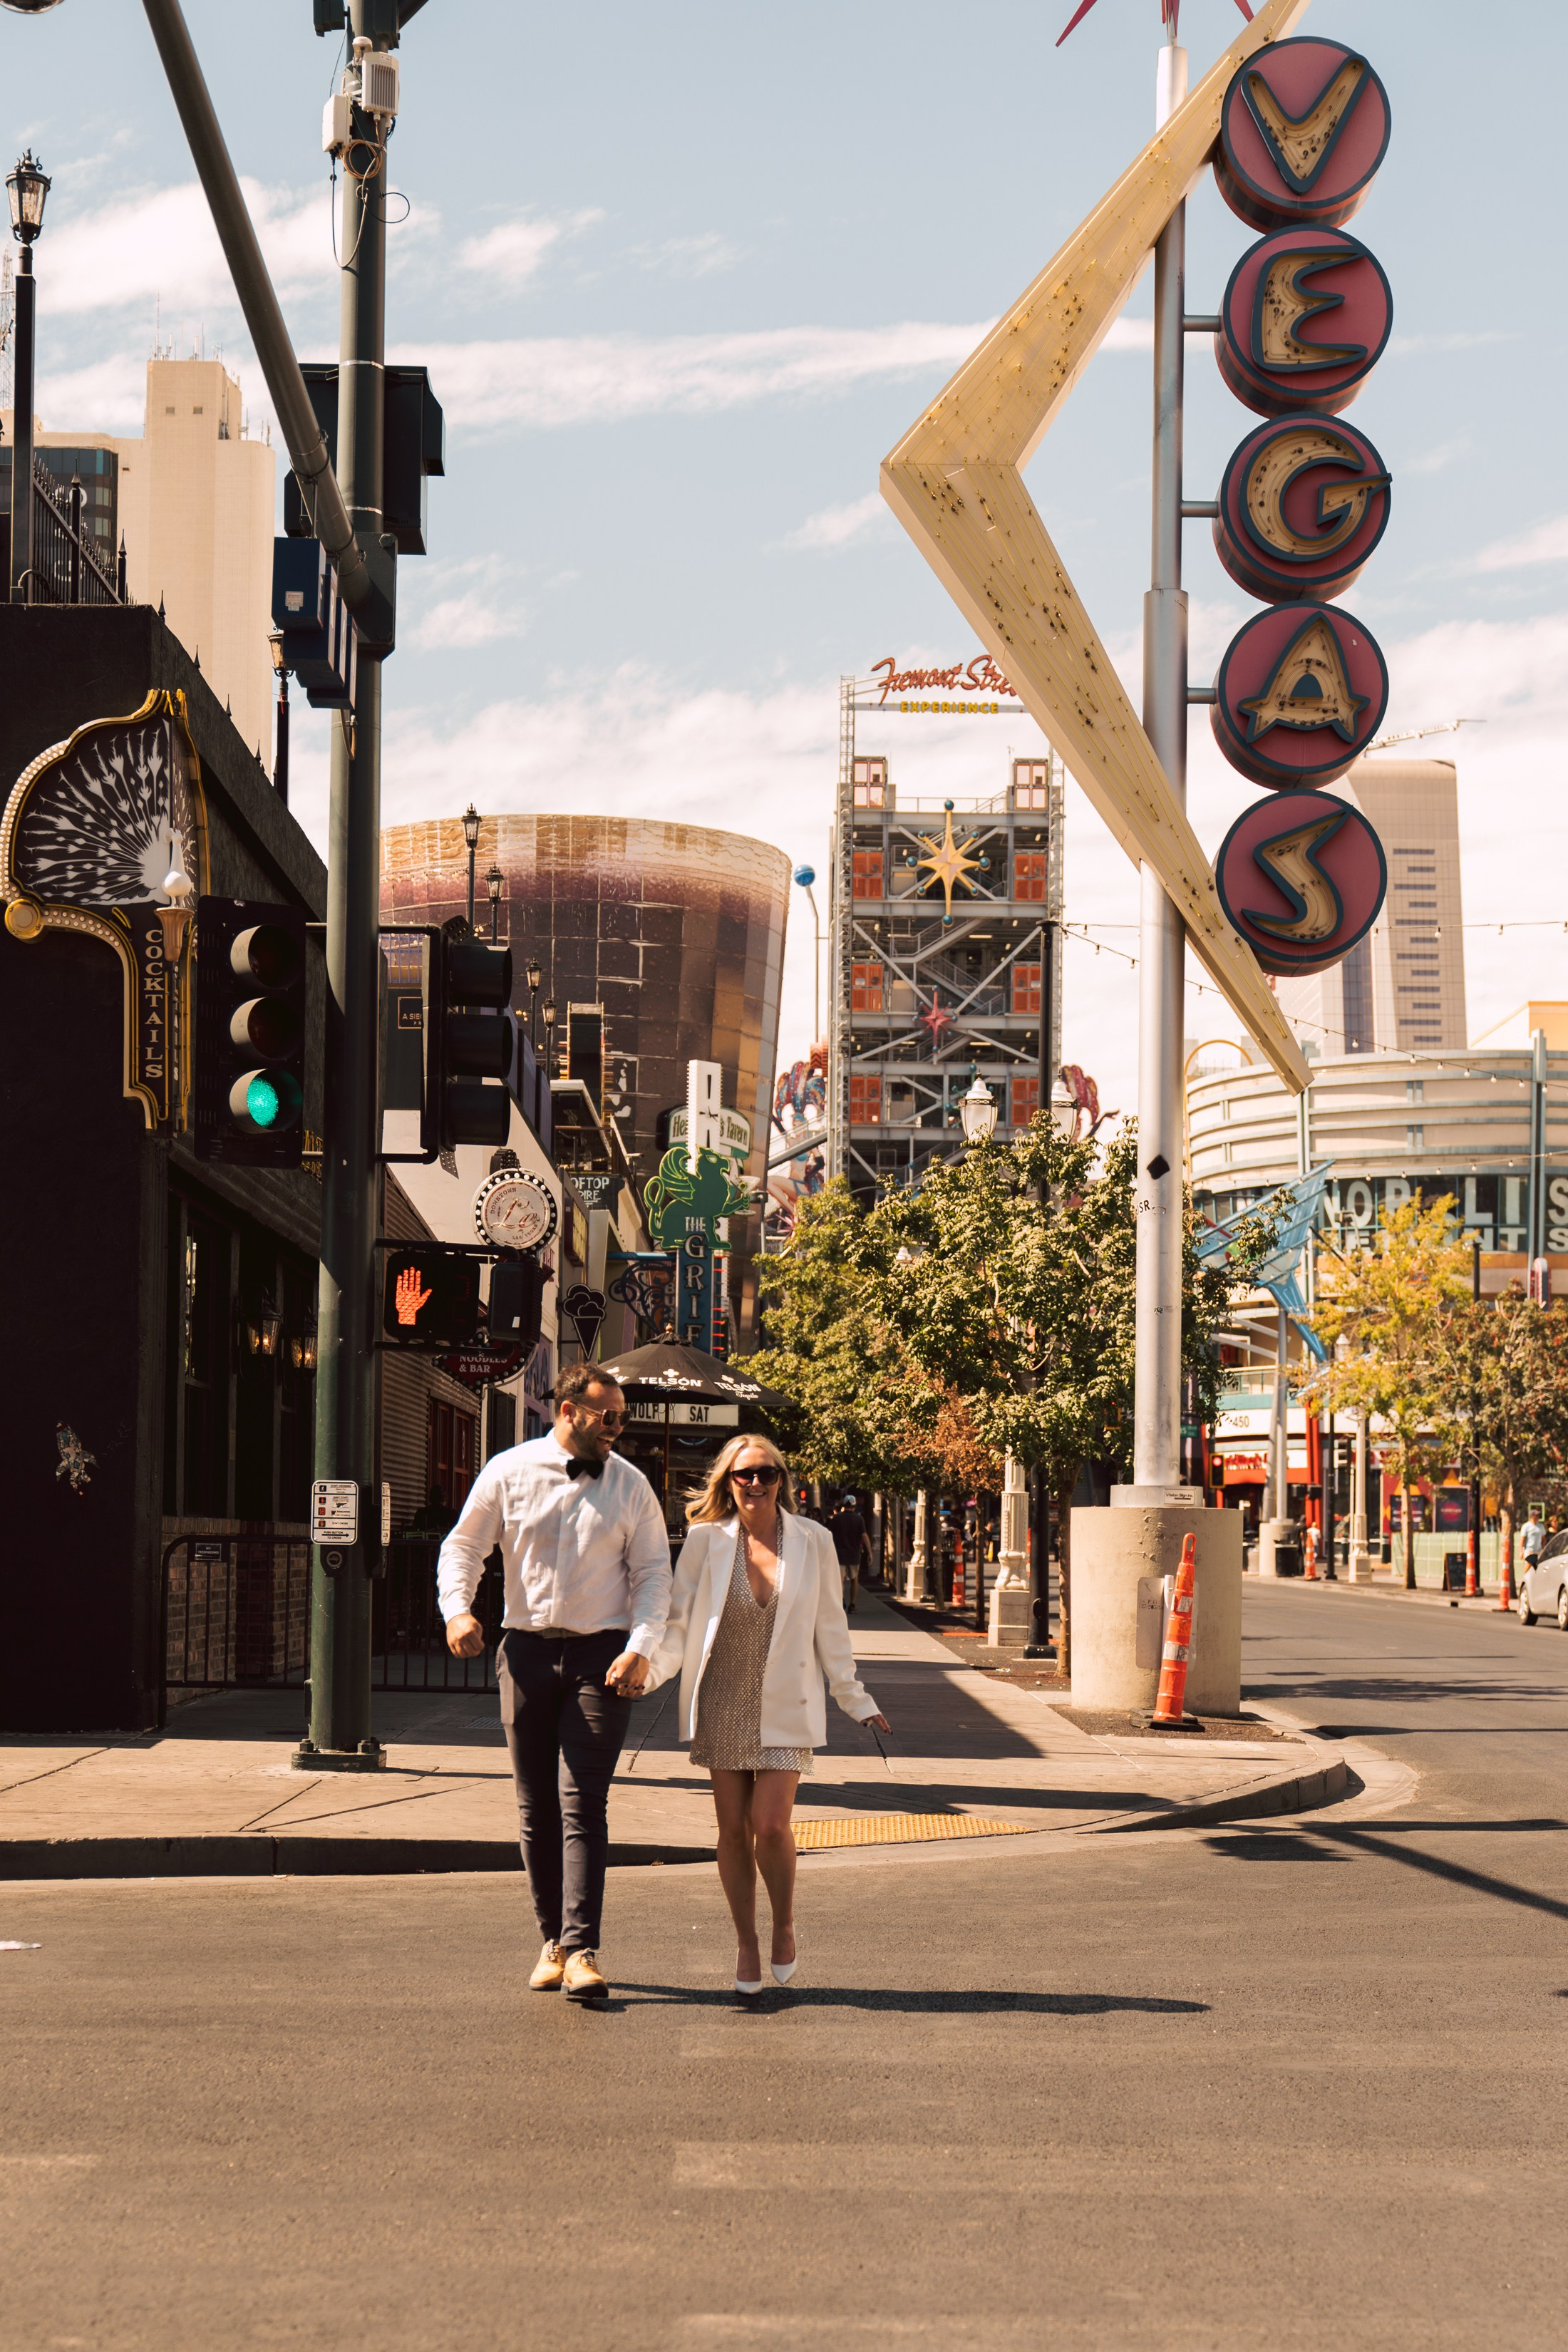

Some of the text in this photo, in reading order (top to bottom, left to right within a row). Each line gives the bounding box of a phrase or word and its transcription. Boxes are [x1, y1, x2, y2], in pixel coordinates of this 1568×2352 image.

[1238, 53, 1392, 944] VEGAS
[871, 657, 962, 706] Fremont
[900, 701, 999, 713] EXPERIENCE
[143, 929, 164, 1078] COCKTAILS
[726, 1115, 748, 1146] Tavern
[490, 1187, 517, 1214] DOWNTOWN
[524, 1224, 538, 1237] VEGAS
[685, 1217, 706, 1232] THE
[459, 1364, 467, 1373] &
[689, 1406, 709, 1423] SAT
[1234, 1415, 1249, 1428] 450
